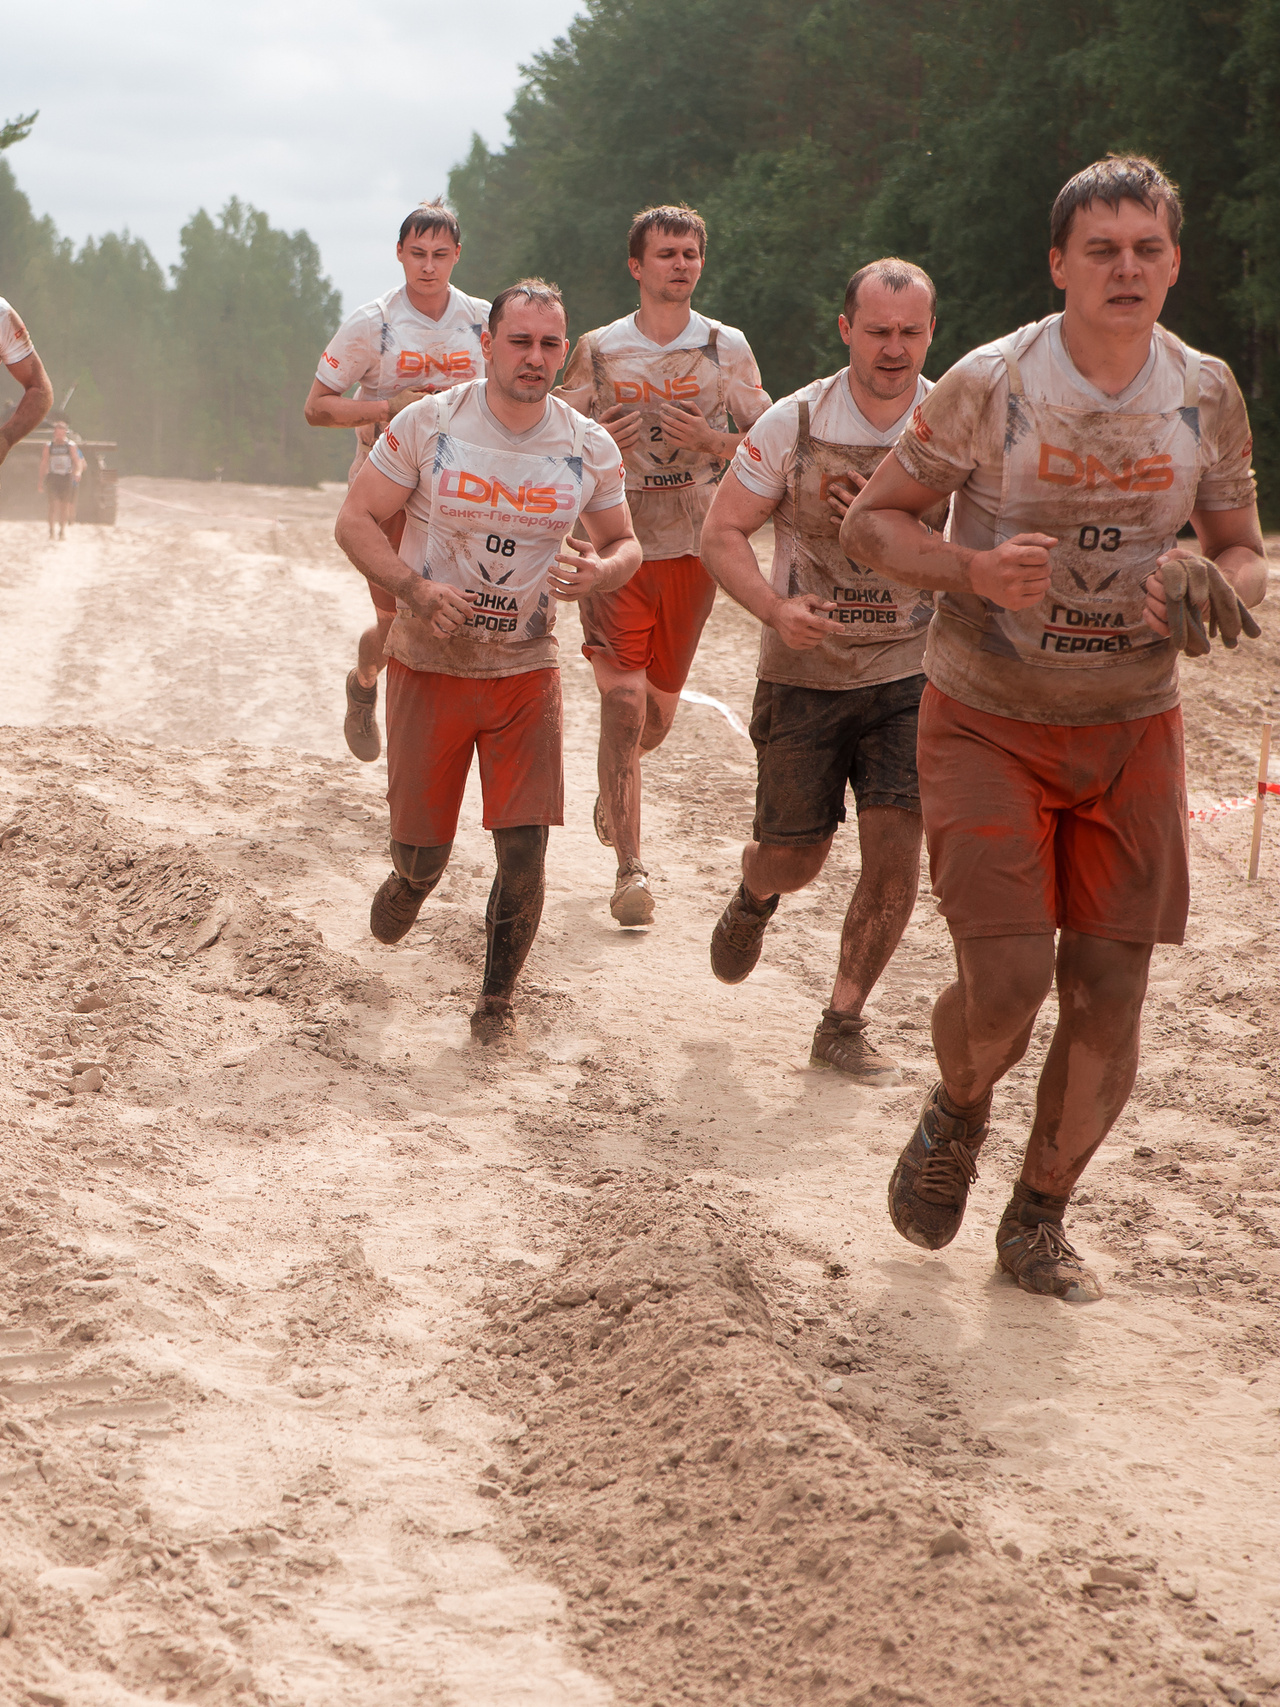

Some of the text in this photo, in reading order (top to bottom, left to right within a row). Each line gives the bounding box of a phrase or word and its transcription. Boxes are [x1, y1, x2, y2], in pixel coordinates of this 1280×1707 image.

[400, 350, 471, 373] DNS
[614, 375, 701, 404] DNS
[644, 471, 693, 486] ГОНКА
[1038, 442, 1175, 492] DNS
[457, 470, 558, 514] DNS
[439, 504, 569, 531] Санкт-Петербург
[485, 533, 516, 557] 08
[1078, 525, 1122, 552] 03
[833, 586, 893, 604] ГОНКА
[828, 608, 897, 624] ГЕРОЕВ
[1050, 604, 1128, 628] ГОНКА
[1040, 632, 1132, 653] ГЕРОЕВ
